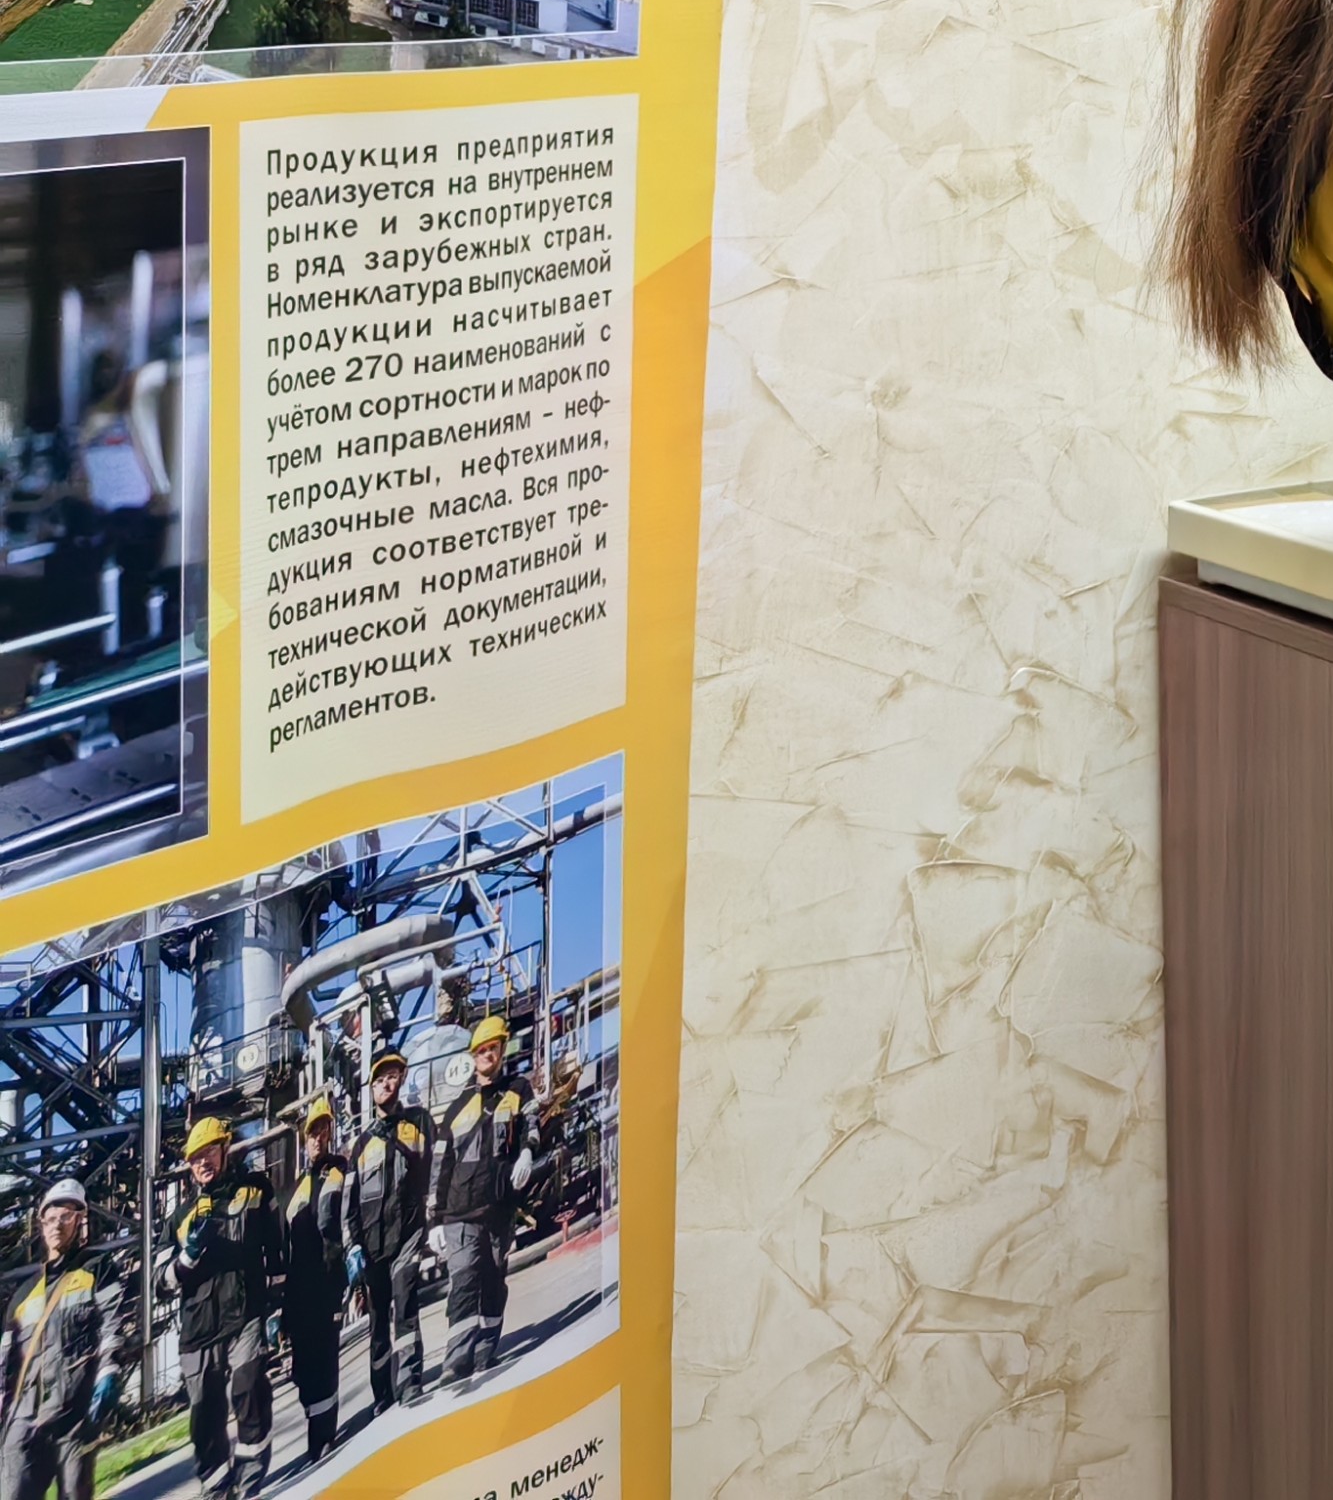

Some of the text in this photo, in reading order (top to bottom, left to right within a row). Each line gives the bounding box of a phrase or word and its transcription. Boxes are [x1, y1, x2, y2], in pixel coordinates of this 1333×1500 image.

[267, 127, 614, 178] Продукция предприятия
[267, 159, 613, 215] реализуется на внутреннем
[267, 191, 613, 252] рынке и экспортируется
[267, 222, 612, 283] в ряд зарубежных стран.
[267, 249, 611, 318] Номенклатура выпускаемой
[267, 286, 612, 361] продукции насчитывает
[267, 323, 611, 396] более 270 наименований с
[267, 358, 610, 441] учётом сортности и марок по
[267, 445, 322, 479] трем
[337, 408, 531, 462] направлениям
[565, 391, 611, 420] неф-
[267, 429, 609, 514] тепродукты, нефтехимия,
[268, 464, 610, 554] смазочные масла. Вся про-
[267, 498, 609, 596] дукция соответствует тре-
[268, 531, 607, 631] бованиям нормативной и
[268, 567, 607, 670] технической документации,
[268, 599, 607, 713] действующих технических
[269, 685, 436, 753] регламентов.
[511, 1436, 604, 1498] менедж-
[551, 1472, 604, 1500] жду-
